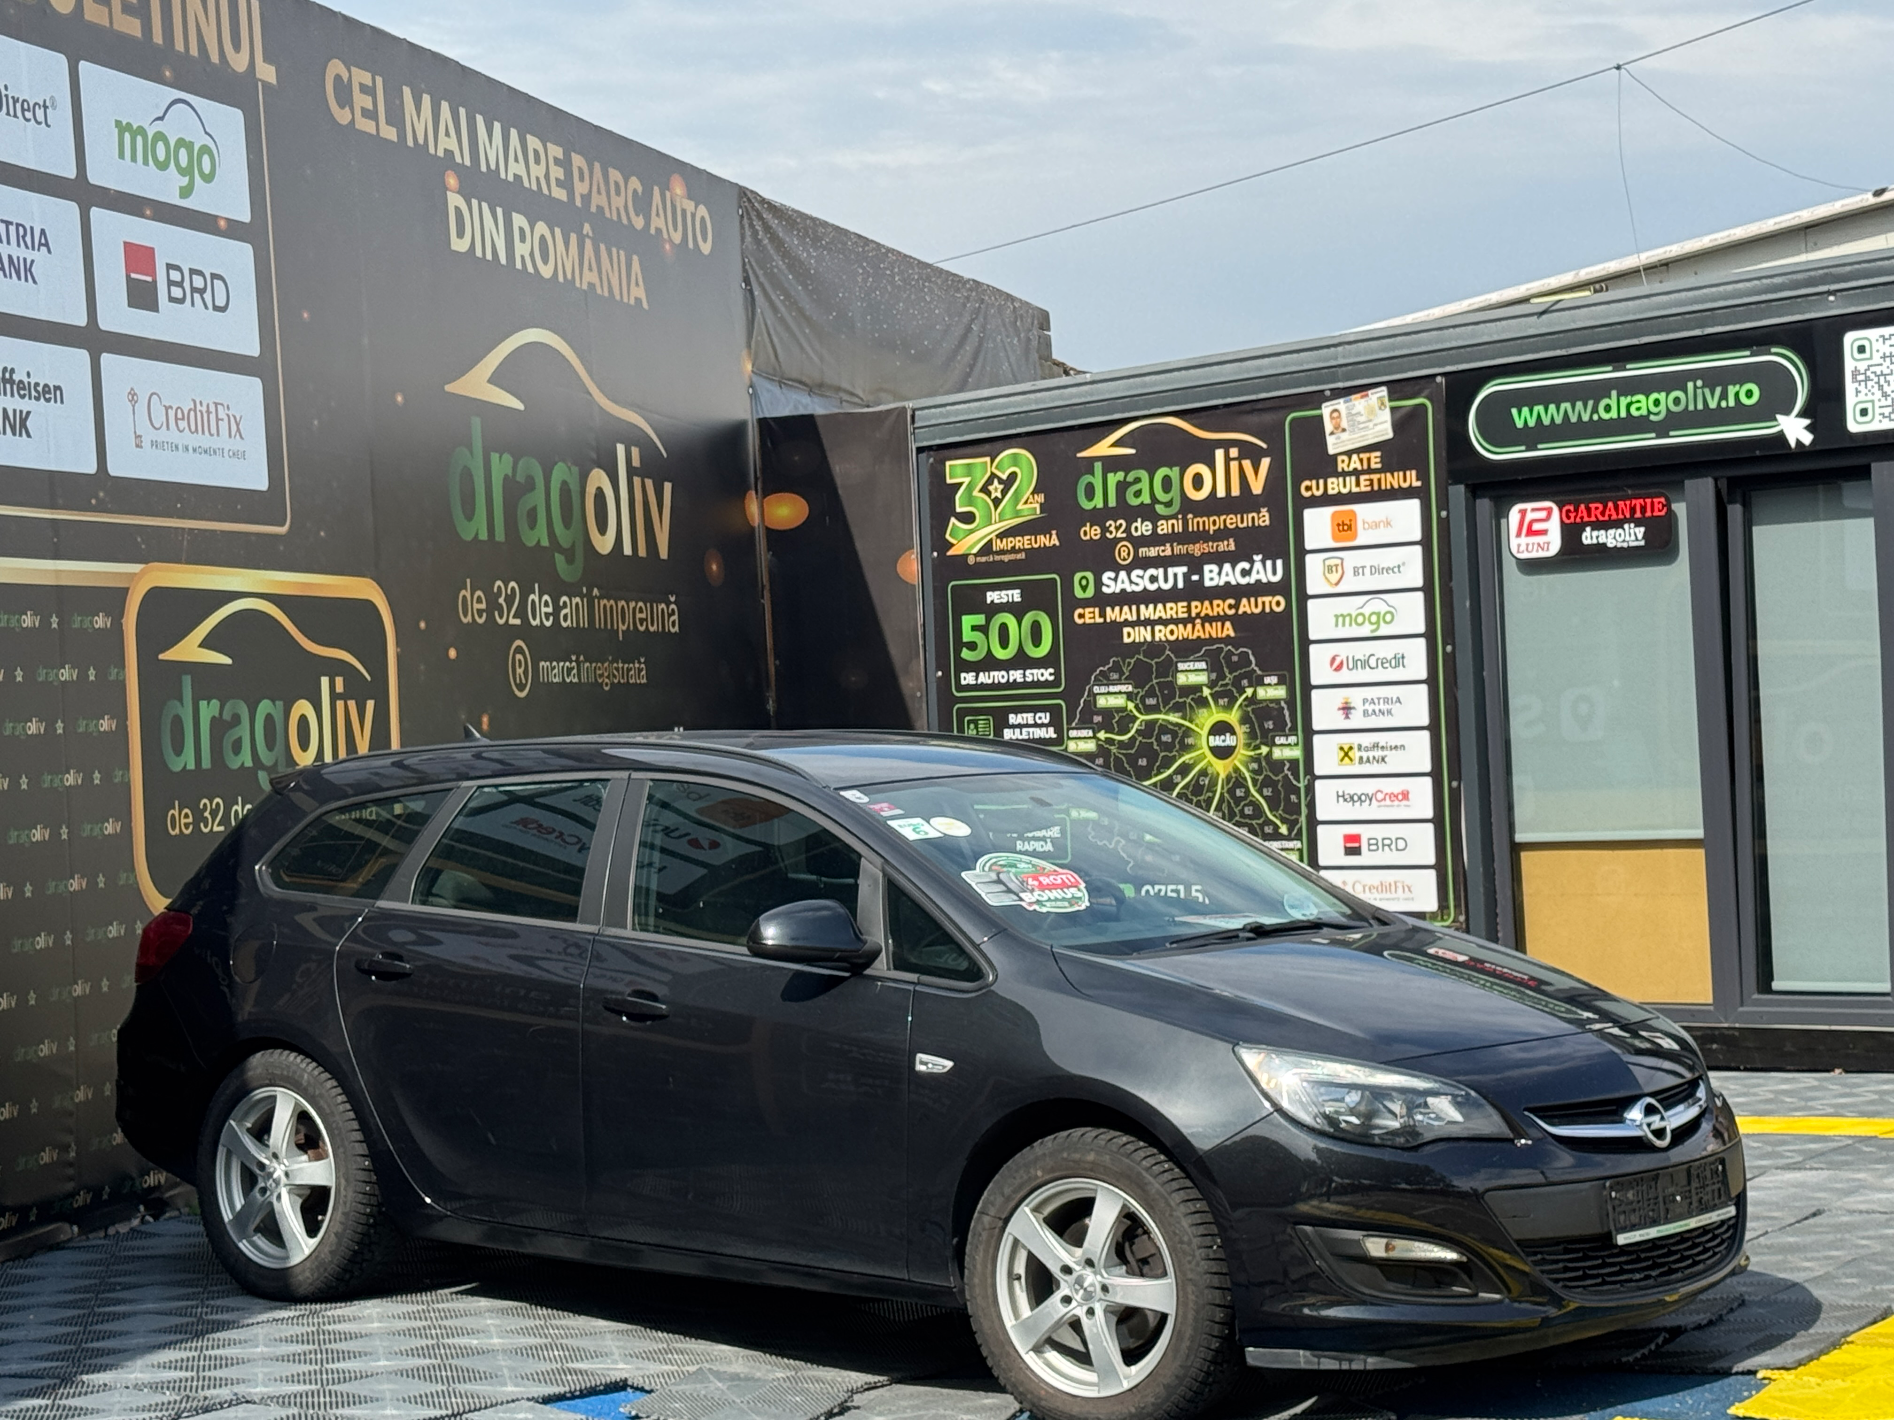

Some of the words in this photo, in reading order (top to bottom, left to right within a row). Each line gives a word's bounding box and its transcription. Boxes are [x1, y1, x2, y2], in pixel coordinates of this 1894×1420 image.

[114, 118, 217, 200] mogo
[325, 58, 397, 143] CEL
[402, 84, 471, 167] MAI
[476, 113, 567, 203] MARE
[571, 152, 645, 231] PARC
[649, 185, 712, 256] AUTO
[0, 218, 52, 255] TRIA
[446, 190, 507, 266] DIN
[511, 211, 649, 310] ROMÂNIA
[165, 262, 230, 314] BRD
[1510, 378, 1761, 430] www.dragoliv.ro
[147, 391, 245, 441] CreditFix
[150, 439, 179, 453] PRIETEN
[181, 443, 190, 455] IN
[192, 445, 225, 458] MOMENTE
[227, 448, 247, 461] CHEIE
[1336, 451, 1382, 472] RATE
[1076, 447, 1271, 516] dragoliv
[1300, 479, 1325, 497] CU
[1326, 469, 1422, 495] BULETINUL
[448, 416, 673, 582] dragoliv
[945, 448, 1038, 545] 32
[1026, 493, 1045, 505] ANI
[1561, 496, 1668, 524] GARANTIE
[1079, 522, 1101, 541] de
[1105, 519, 1127, 538] 32
[1131, 517, 1152, 537] de
[1156, 514, 1183, 535] ani
[1187, 507, 1271, 535] împreună
[1336, 519, 1353, 533] tbi
[1362, 517, 1393, 531] bank
[1515, 506, 1553, 539] 12
[992, 530, 1060, 551] ÎMPREUNĂ
[1581, 523, 1646, 548] dragoliv
[1138, 542, 1172, 558] marcă
[1173, 538, 1236, 557] înregistrată
[1516, 541, 1551, 554] LUNI
[1101, 565, 1188, 595] SASCUT
[1203, 554, 1284, 587] BACĂU
[1327, 564, 1340, 574] BT
[1353, 565, 1367, 577] BT
[986, 589, 1022, 604] PESTE
[458, 578, 487, 624] de
[493, 580, 522, 625] 32
[527, 583, 553, 628] de
[559, 586, 588, 628] ani
[592, 587, 680, 641] împreună
[1073, 606, 1104, 625] CEL
[1106, 604, 1138, 623] MAI
[1139, 601, 1188, 621] MARE
[1190, 598, 1236, 617] PARC
[1237, 595, 1286, 614] AUTO
[71, 612, 112, 632] dragoliv
[1122, 626, 1151, 643] DIN
[1154, 619, 1236, 642] ROMÂNIA
[1333, 610, 1395, 634] mogo
[960, 610, 1053, 662] 500
[539, 654, 579, 684] marcă
[579, 656, 648, 691] înregistrată
[1346, 652, 1406, 671] UniCredit
[36, 664, 79, 686] dragoliv
[960, 672, 977, 685] DE
[977, 670, 1008, 684] AUTO
[1009, 669, 1025, 683] PE
[1025, 668, 1056, 682] STOC
[1362, 696, 1402, 707] PATRIA
[1362, 707, 1394, 718] BANK
[3, 717, 46, 739] dragoliv
[76, 714, 117, 738] dragoliv
[1008, 712, 1035, 726] RATE
[1035, 711, 1050, 724] CU
[160, 674, 375, 792] dragoliv
[1003, 727, 1058, 740] BULETINUL
[1208, 732, 1237, 748] BACĂU
[1357, 742, 1406, 752] Raiffeisen
[1357, 755, 1388, 765] BANK
[41, 769, 83, 791] dragoliv
[1336, 789, 1410, 807] HappyCredit
[167, 800, 194, 836] de
[199, 797, 225, 834] 32
[1016, 839, 1054, 852] RAPIDĂ
[1367, 837, 1408, 852] BRD
[1028, 878, 1039, 886] 4
[1352, 880, 1413, 895] CreditFix
[1019, 887, 1082, 902] BONUS
